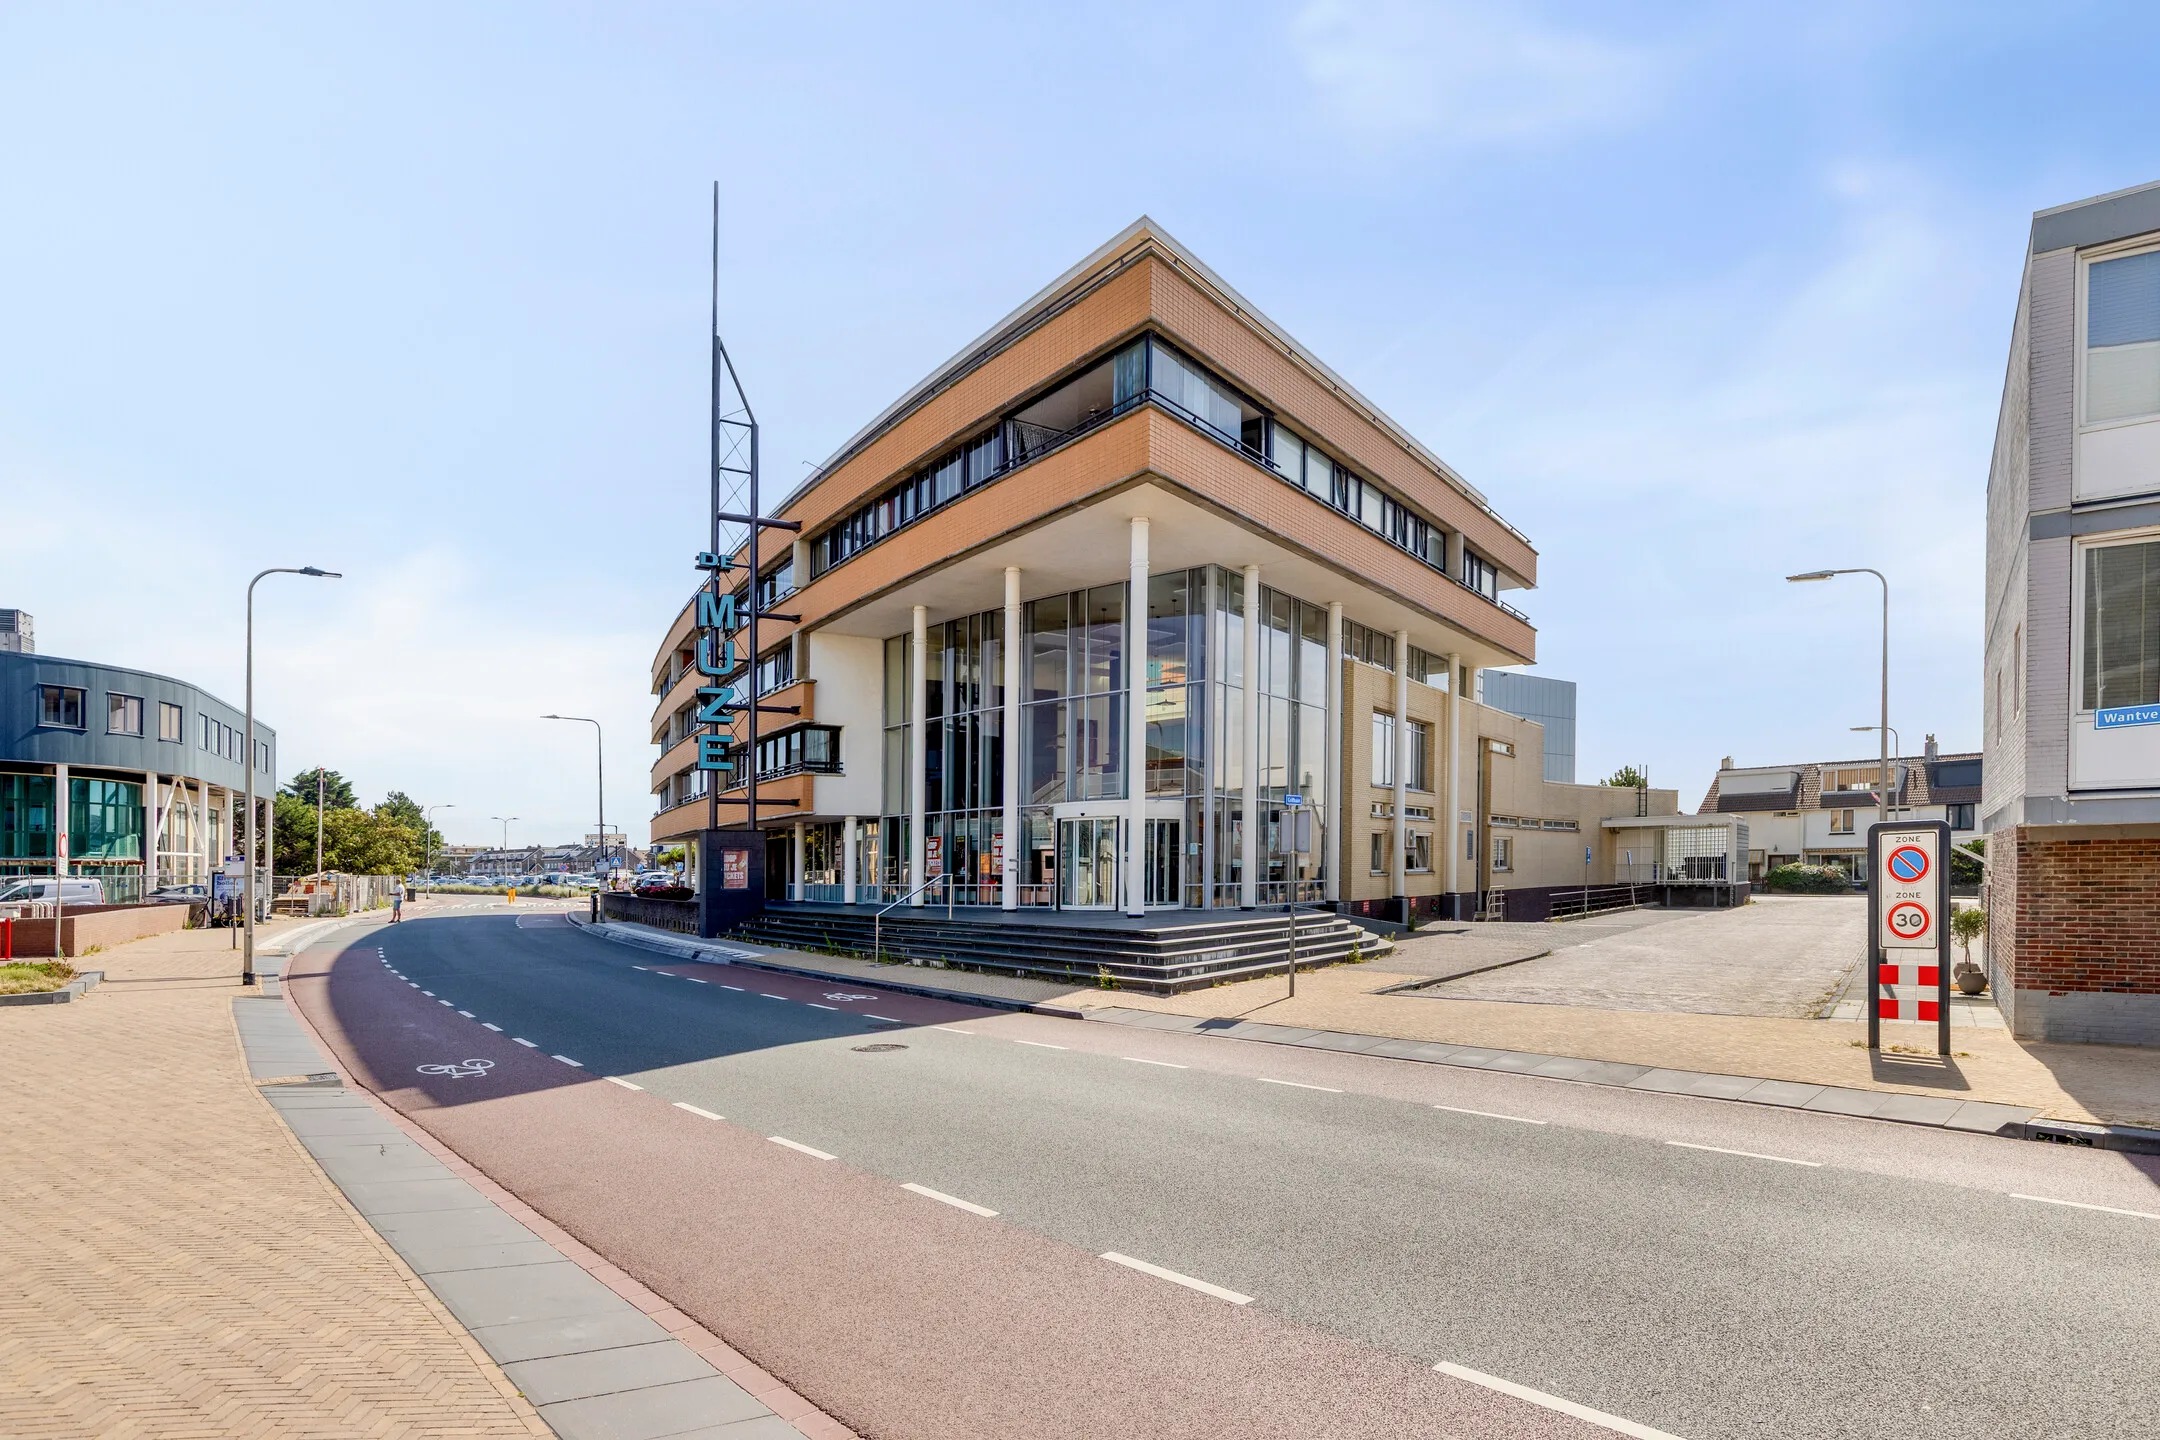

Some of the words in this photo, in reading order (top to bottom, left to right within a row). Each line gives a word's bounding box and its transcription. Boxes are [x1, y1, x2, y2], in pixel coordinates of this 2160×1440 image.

[699, 552, 735, 569] DE
[699, 591, 735, 770] MUZE
[1895, 835, 1921, 843] ZONE
[1896, 913, 1922, 927] 30
